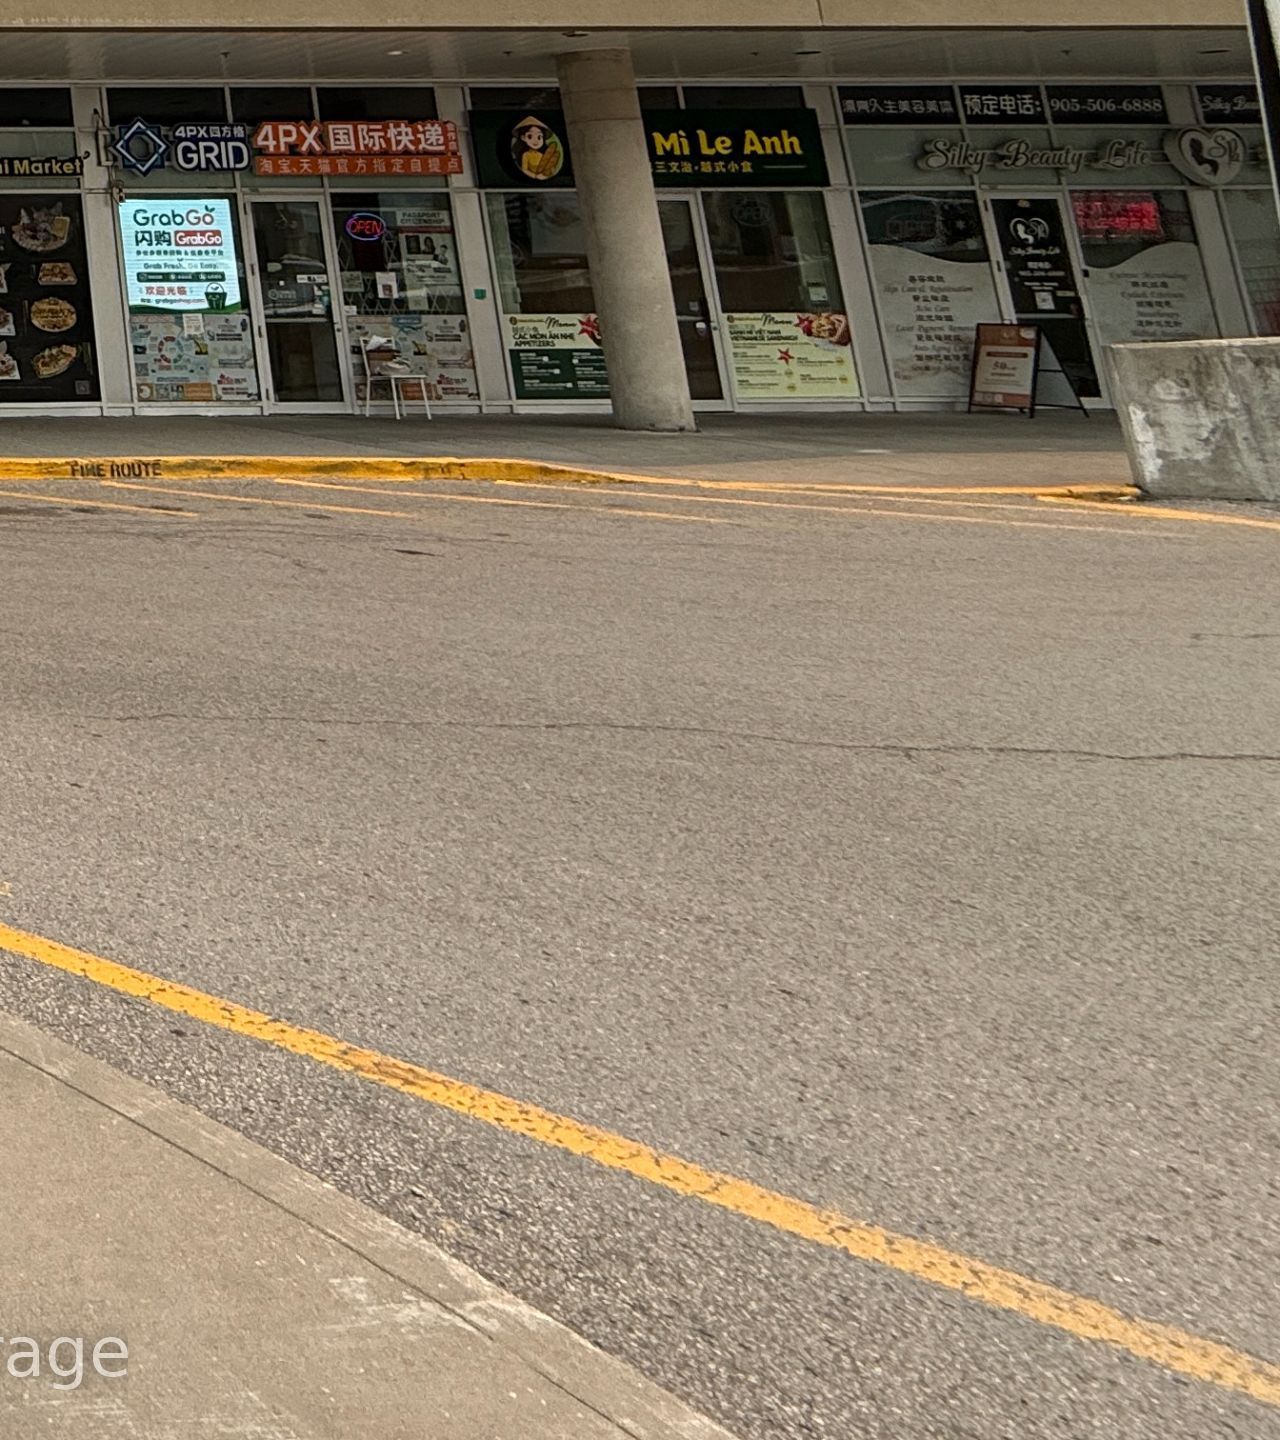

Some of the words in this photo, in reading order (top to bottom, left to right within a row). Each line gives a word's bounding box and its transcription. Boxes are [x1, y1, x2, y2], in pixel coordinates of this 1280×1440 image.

[1050, 97, 1163, 113] 905-506-6888
[696, 129, 733, 155] Le
[743, 129, 804, 156] Anh
[176, 142, 250, 170] GRID
[924, 138, 988, 174] Silky
[1002, 139, 1086, 173] Beauty
[1100, 138, 1152, 169] Life
[13, 158, 83, 176] Market
[133, 205, 215, 226] GrabGo
[351, 220, 382, 234] OPEN
[176, 232, 222, 245] GrabGo
[71, 462, 106, 477] FIRE
[110, 462, 163, 477] ROUTE
